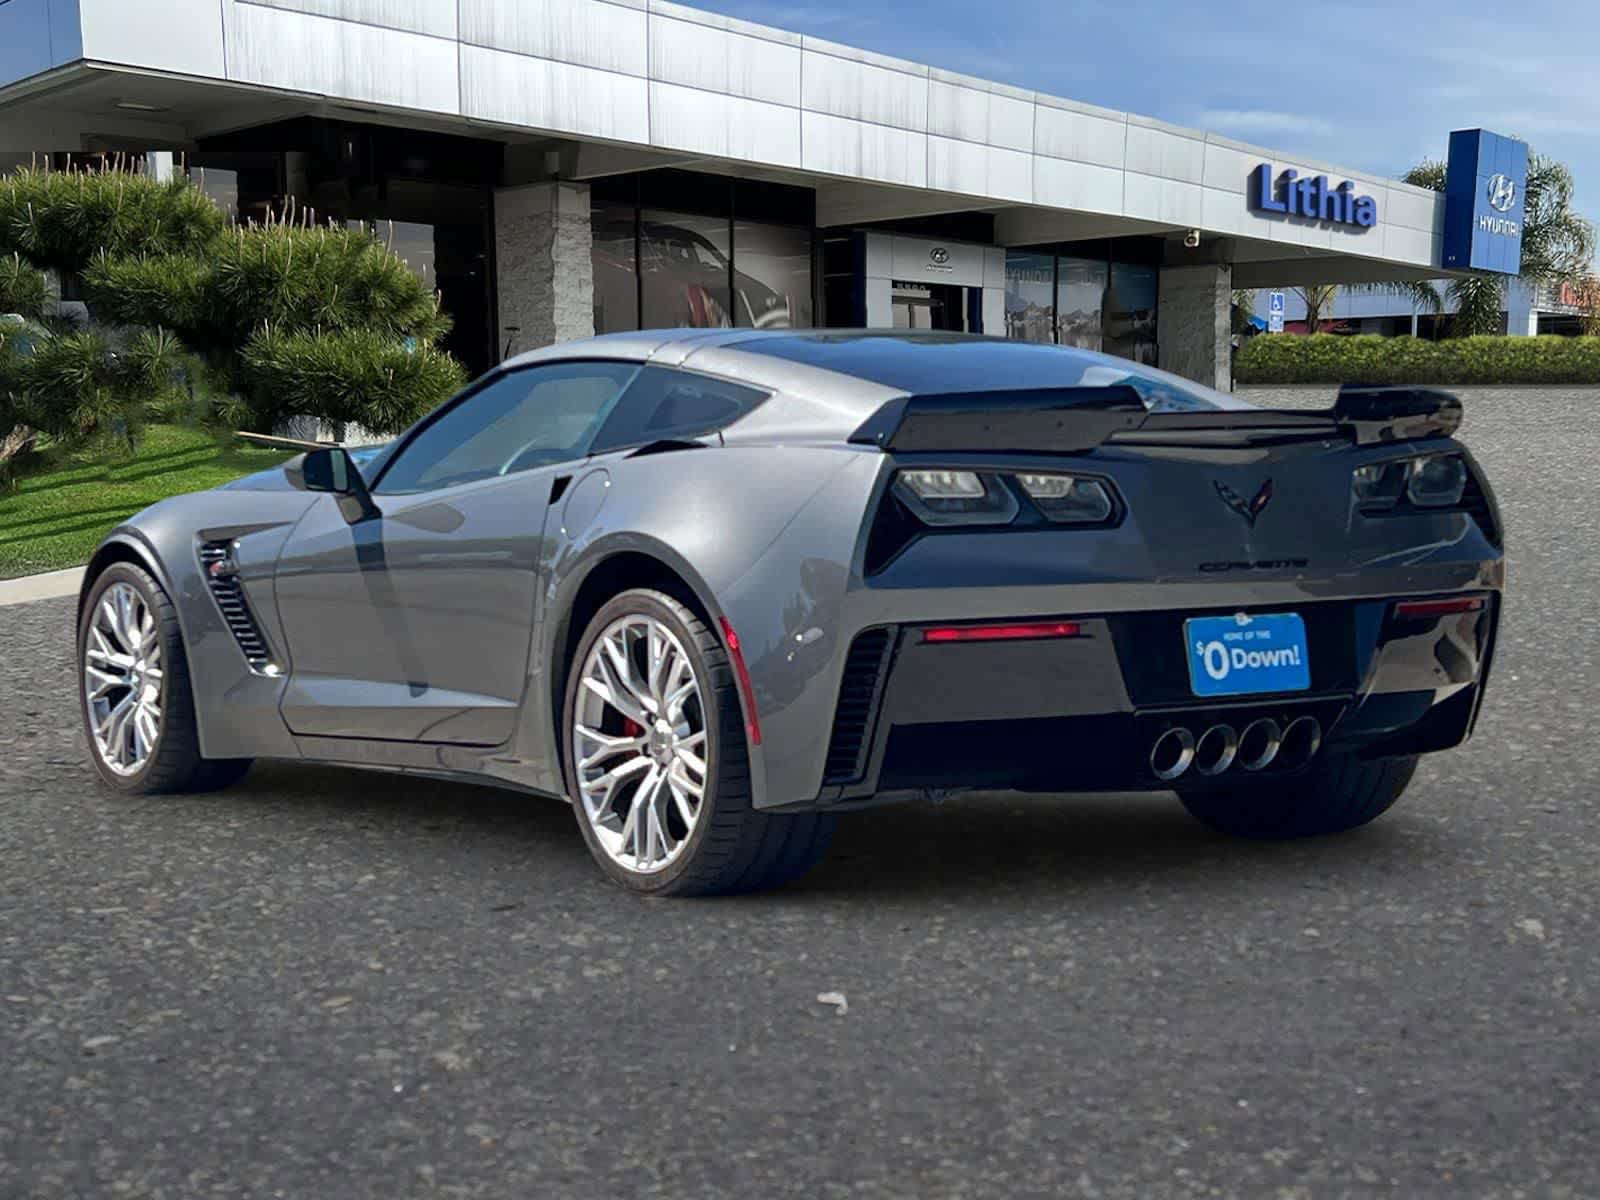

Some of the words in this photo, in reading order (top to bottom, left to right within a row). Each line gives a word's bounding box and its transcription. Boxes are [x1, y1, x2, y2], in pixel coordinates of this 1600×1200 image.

[1247, 163, 1377, 228] Lithia
[1480, 215, 1521, 239] HYUNDAI
[1231, 644, 1301, 669] Down!
